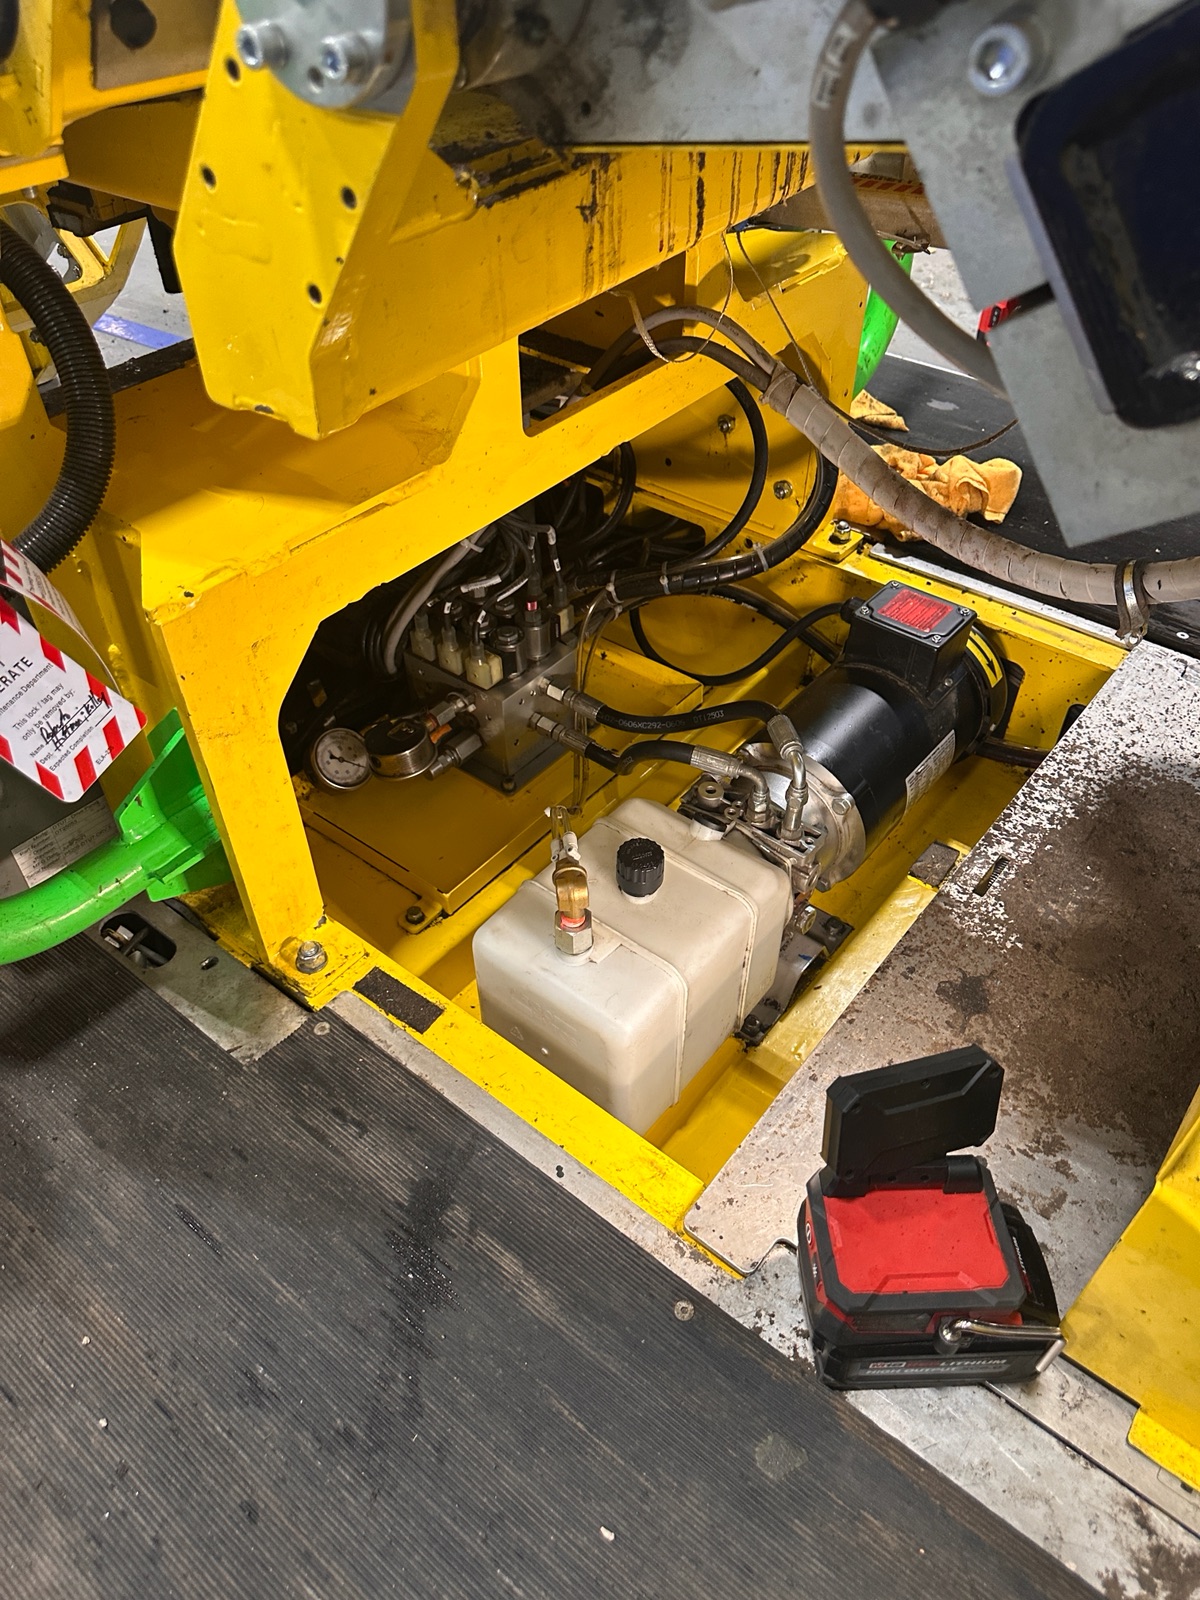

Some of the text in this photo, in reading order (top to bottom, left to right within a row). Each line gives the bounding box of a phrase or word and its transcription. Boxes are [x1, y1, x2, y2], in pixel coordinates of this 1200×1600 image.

[21, 662, 54, 694] Department
[12, 717, 28, 730] This
[25, 705, 39, 720] lock
[40, 694, 54, 705] tag
[51, 683, 64, 696] may
[22, 689, 76, 741] only be removed by:
[29, 744, 45, 758] Name
[50, 726, 95, 771] Expected Completion
